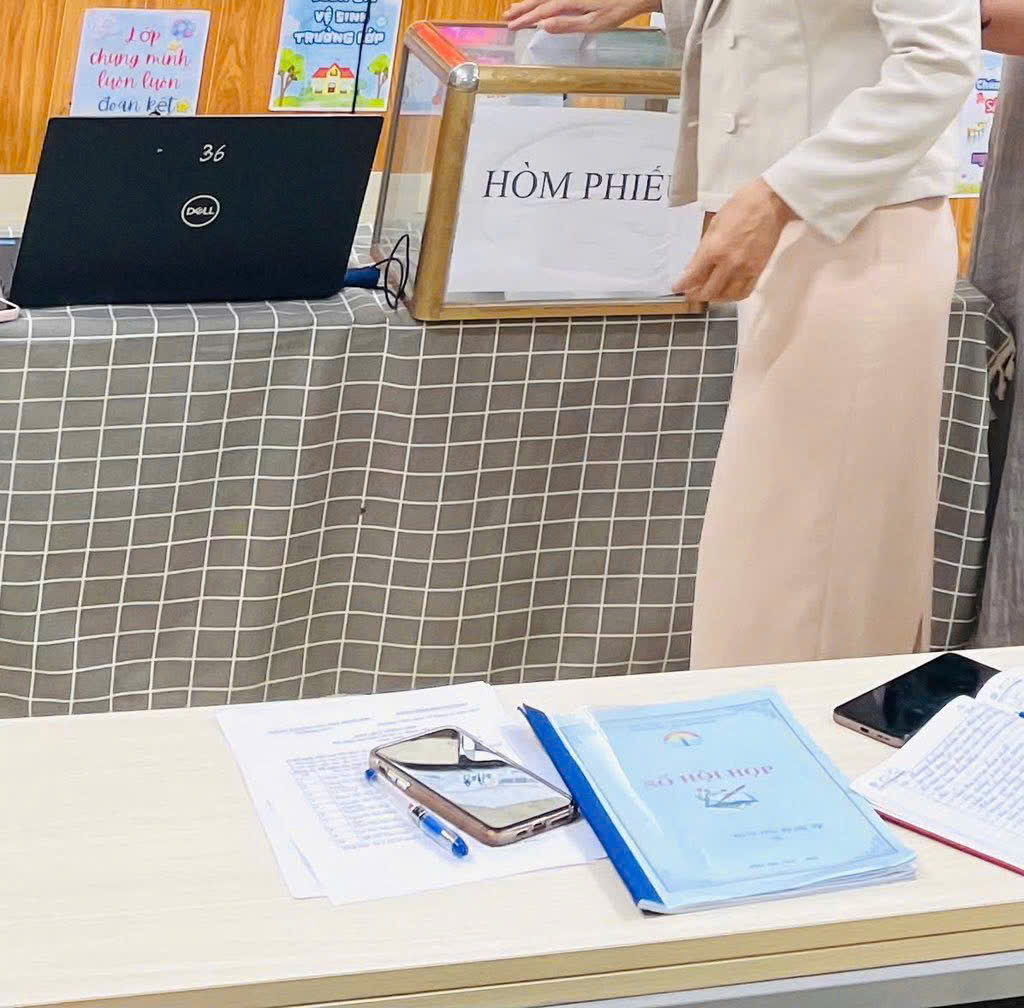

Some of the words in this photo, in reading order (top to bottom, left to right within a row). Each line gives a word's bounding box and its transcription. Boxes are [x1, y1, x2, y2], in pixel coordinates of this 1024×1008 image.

[199, 143, 226, 162] 36
[483, 161, 574, 200] HÒM
[186, 206, 215, 216] DELL
